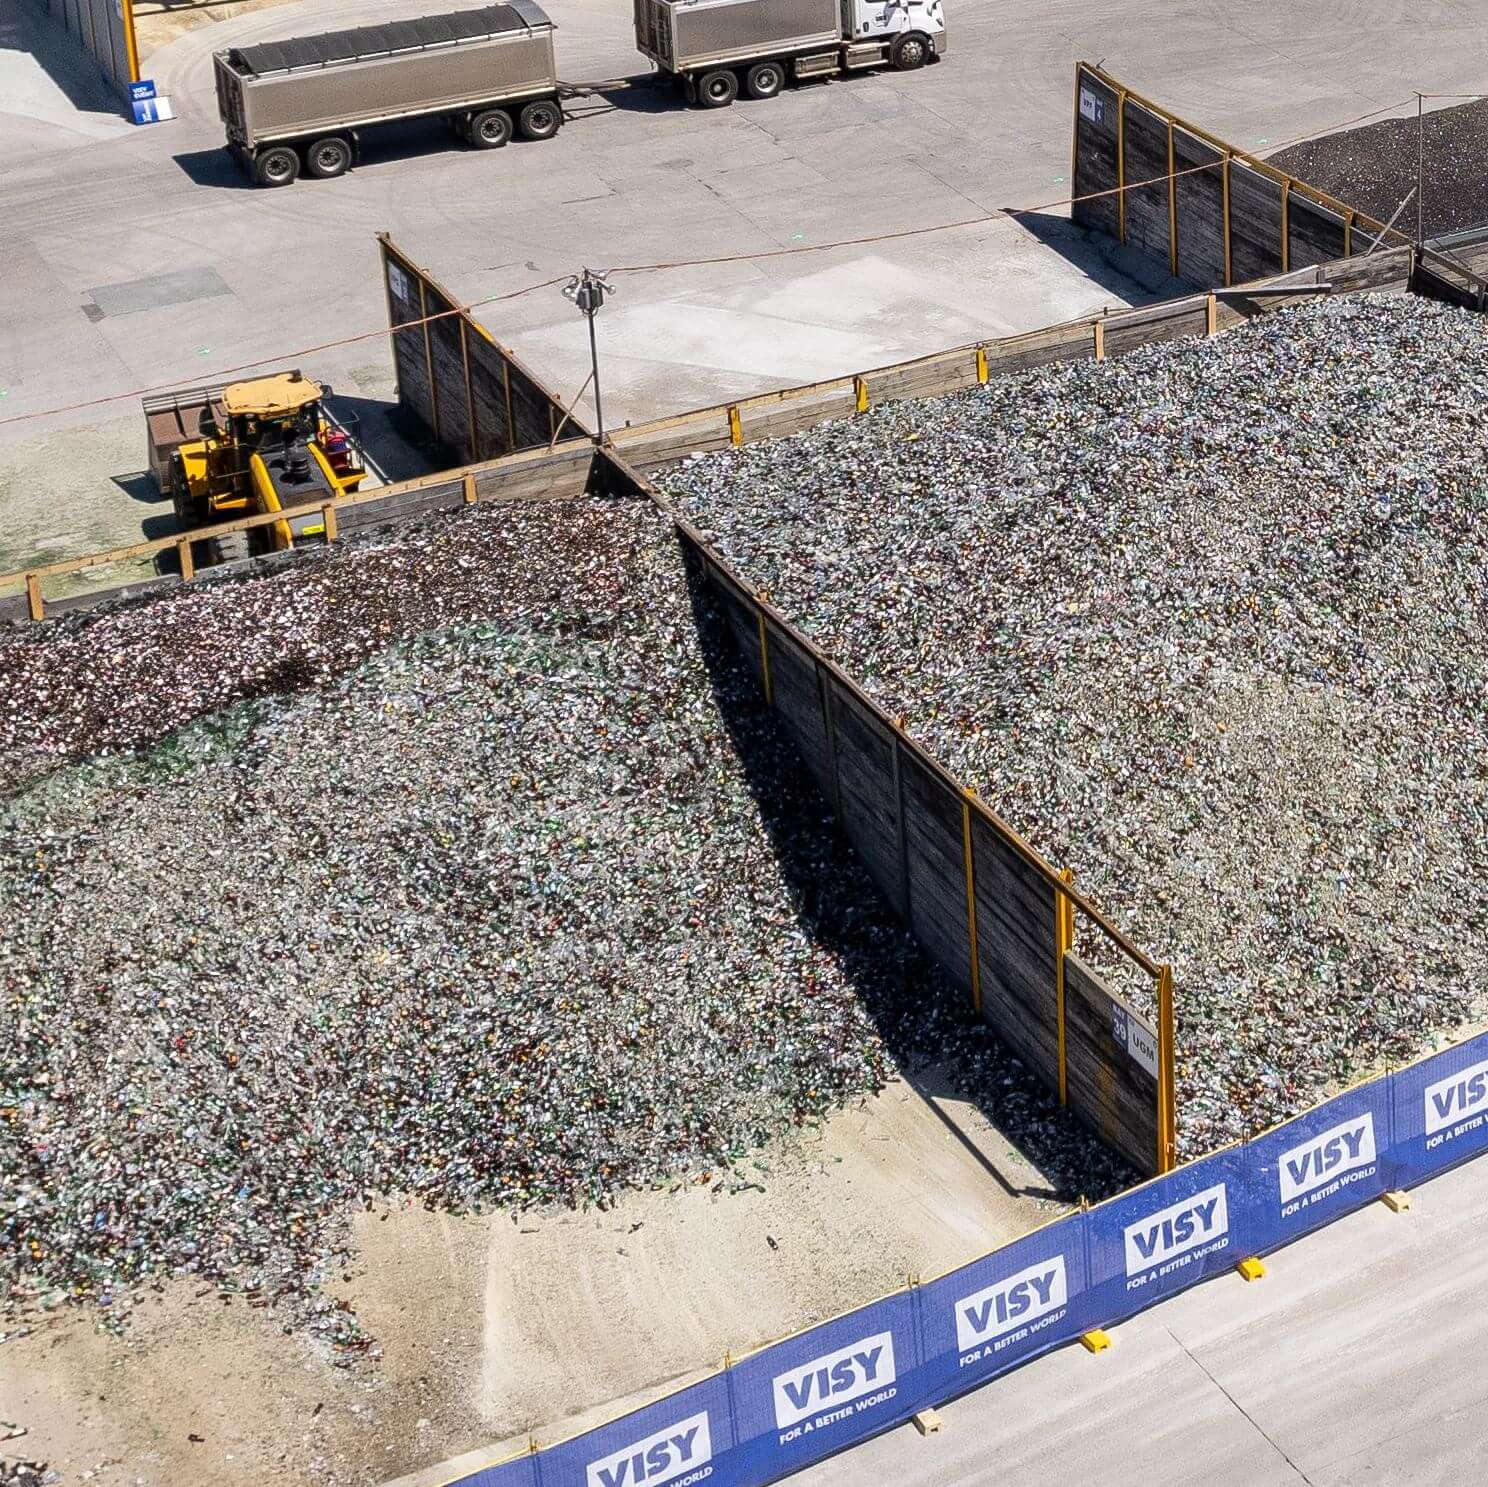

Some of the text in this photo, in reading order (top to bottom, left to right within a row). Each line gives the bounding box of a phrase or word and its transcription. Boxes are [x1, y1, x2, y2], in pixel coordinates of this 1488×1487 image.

[1114, 1018, 1154, 1062] 39 UGM
[1286, 1126, 1366, 1187] VISY
[1426, 1135, 1444, 1150] FOR
[1445, 1131, 1453, 1140] A
[1454, 1116, 1483, 1137] BETTER
[1281, 1166, 1376, 1218] FOR A BETTER WORLD
[1132, 1197, 1218, 1260] VISY
[1126, 1237, 1229, 1292] FOR A BETTER WORLD
[964, 1270, 1056, 1334] VISY
[959, 1310, 1066, 1368] FOR A BETTER WORLD
[783, 1345, 883, 1410] VISY
[779, 1388, 897, 1445] FOR A BETTER WORLD
[597, 1425, 700, 1487] VISY
[669, 1466, 713, 1487] WORLD
